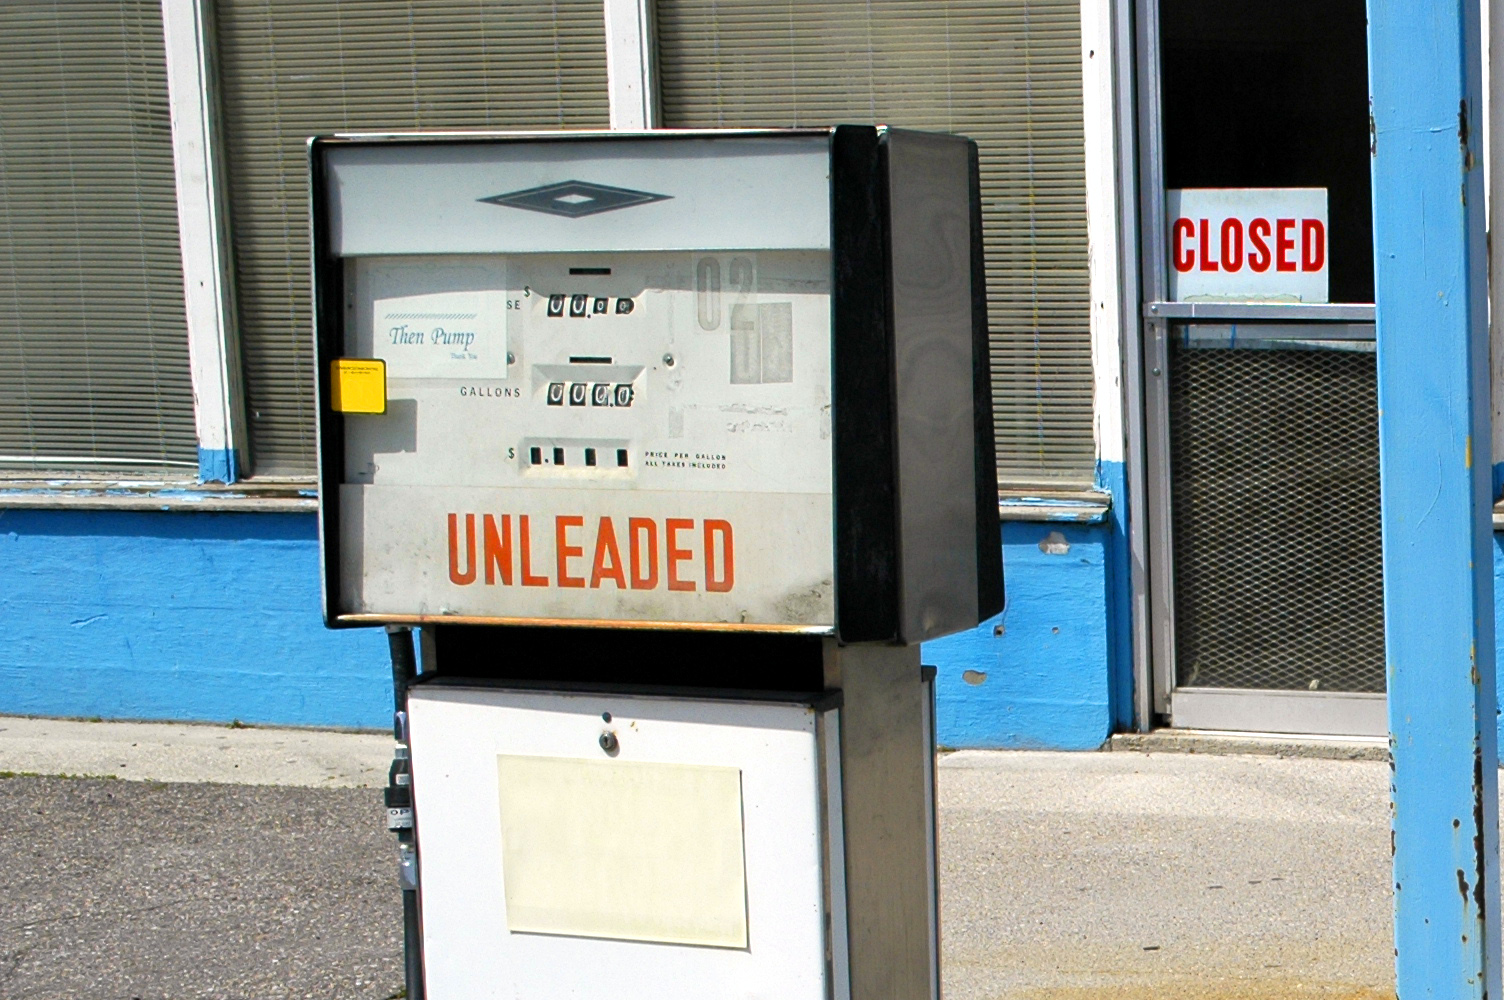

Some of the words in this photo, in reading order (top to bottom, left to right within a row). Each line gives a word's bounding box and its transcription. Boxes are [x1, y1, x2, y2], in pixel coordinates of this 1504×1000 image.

[1173, 217, 1325, 273] CLOSED
[389, 325, 425, 345] Then
[430, 327, 475, 351] Pump
[460, 386, 521, 397] GALLONS
[448, 513, 734, 593] UNLEADED
